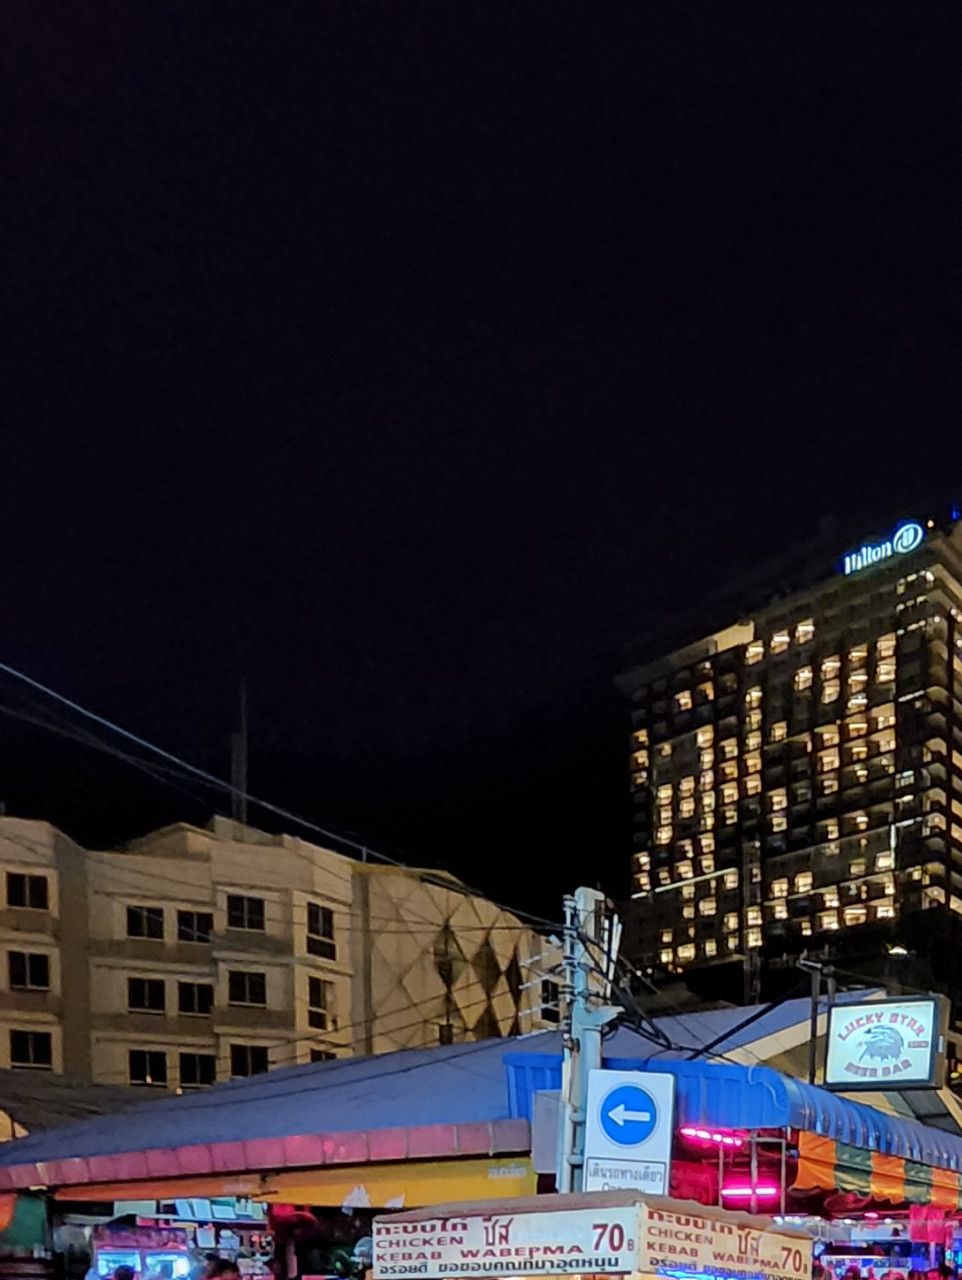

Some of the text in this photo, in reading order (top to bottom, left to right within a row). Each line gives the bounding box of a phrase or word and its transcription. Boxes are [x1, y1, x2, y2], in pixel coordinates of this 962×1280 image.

[845, 541, 892, 576] Hilton
[837, 1011, 925, 1041] LUCKY STAR
[376, 1236, 463, 1249] CHICKEN
[592, 1223, 625, 1252] 70
[647, 1226, 713, 1245] CHICKEN
[376, 1251, 442, 1262] KEBAB
[647, 1241, 698, 1257] KEBAB
[781, 1246, 802, 1272] 70
